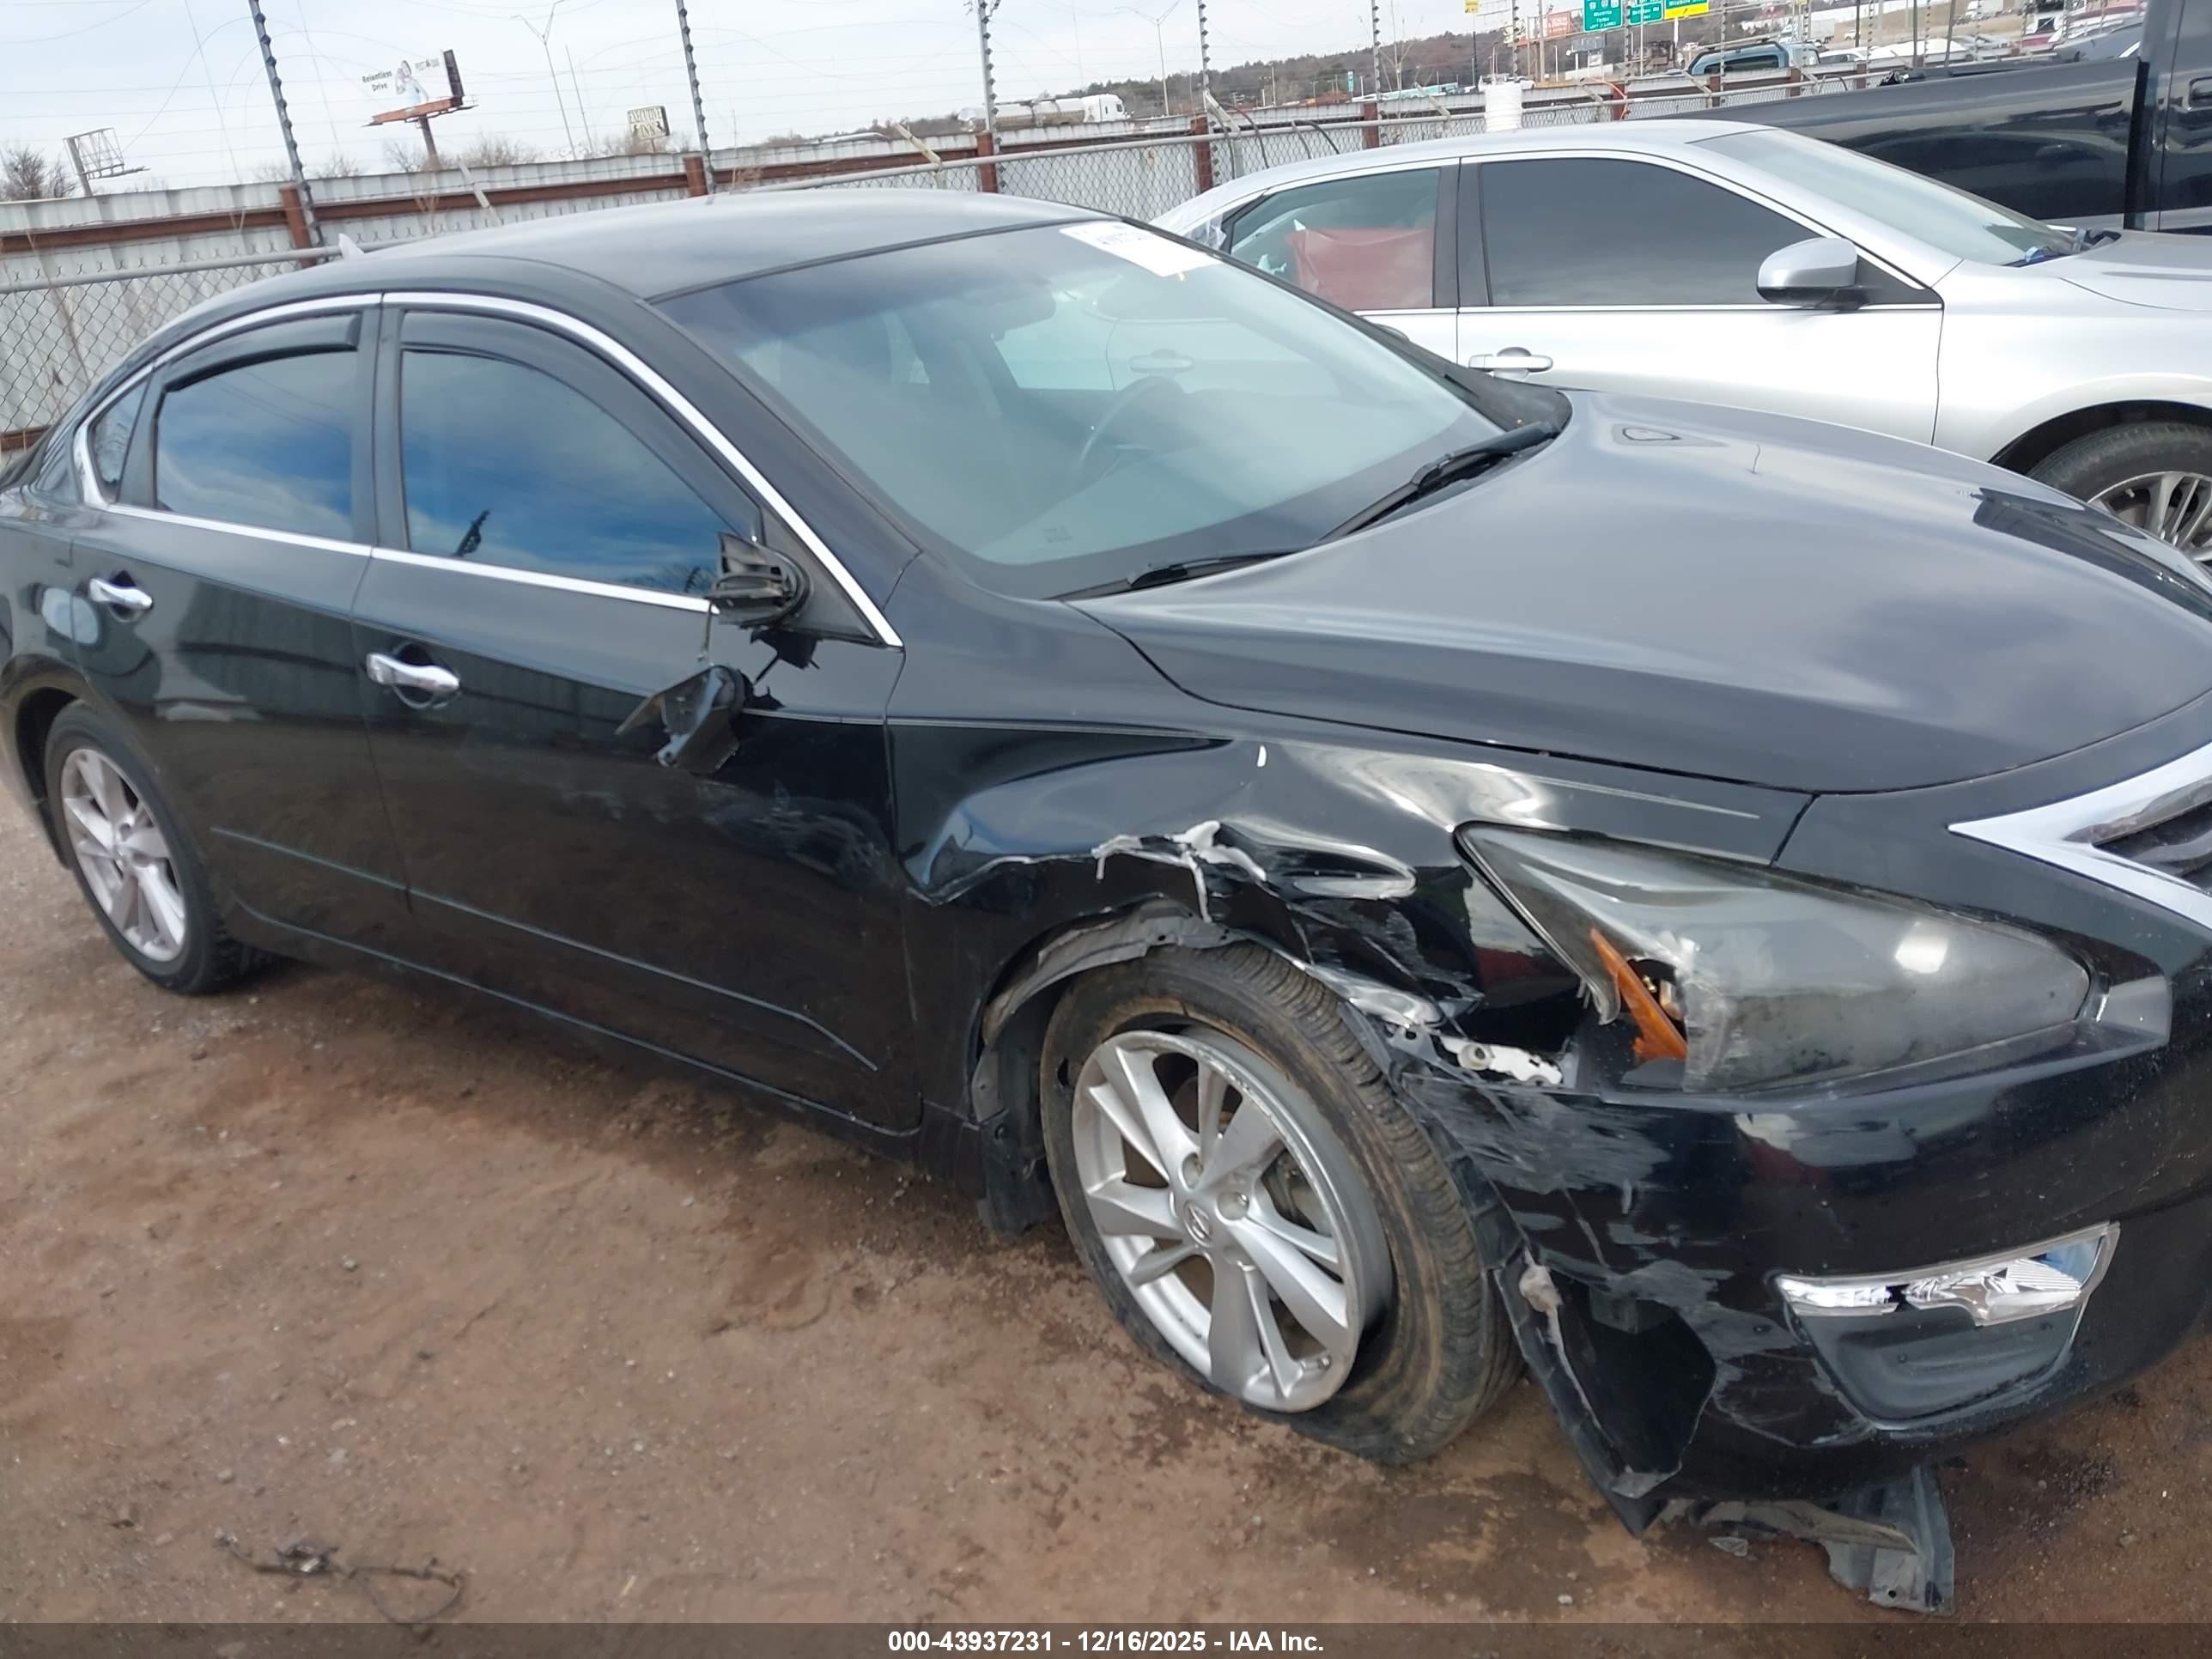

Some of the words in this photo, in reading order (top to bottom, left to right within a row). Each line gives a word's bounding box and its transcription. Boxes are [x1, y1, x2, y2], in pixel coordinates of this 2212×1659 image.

[362, 71, 392, 82] Relentless
[372, 82, 388, 92] Drive
[629, 108, 661, 123] EXECUTIVE
[641, 123, 656, 137] INN
